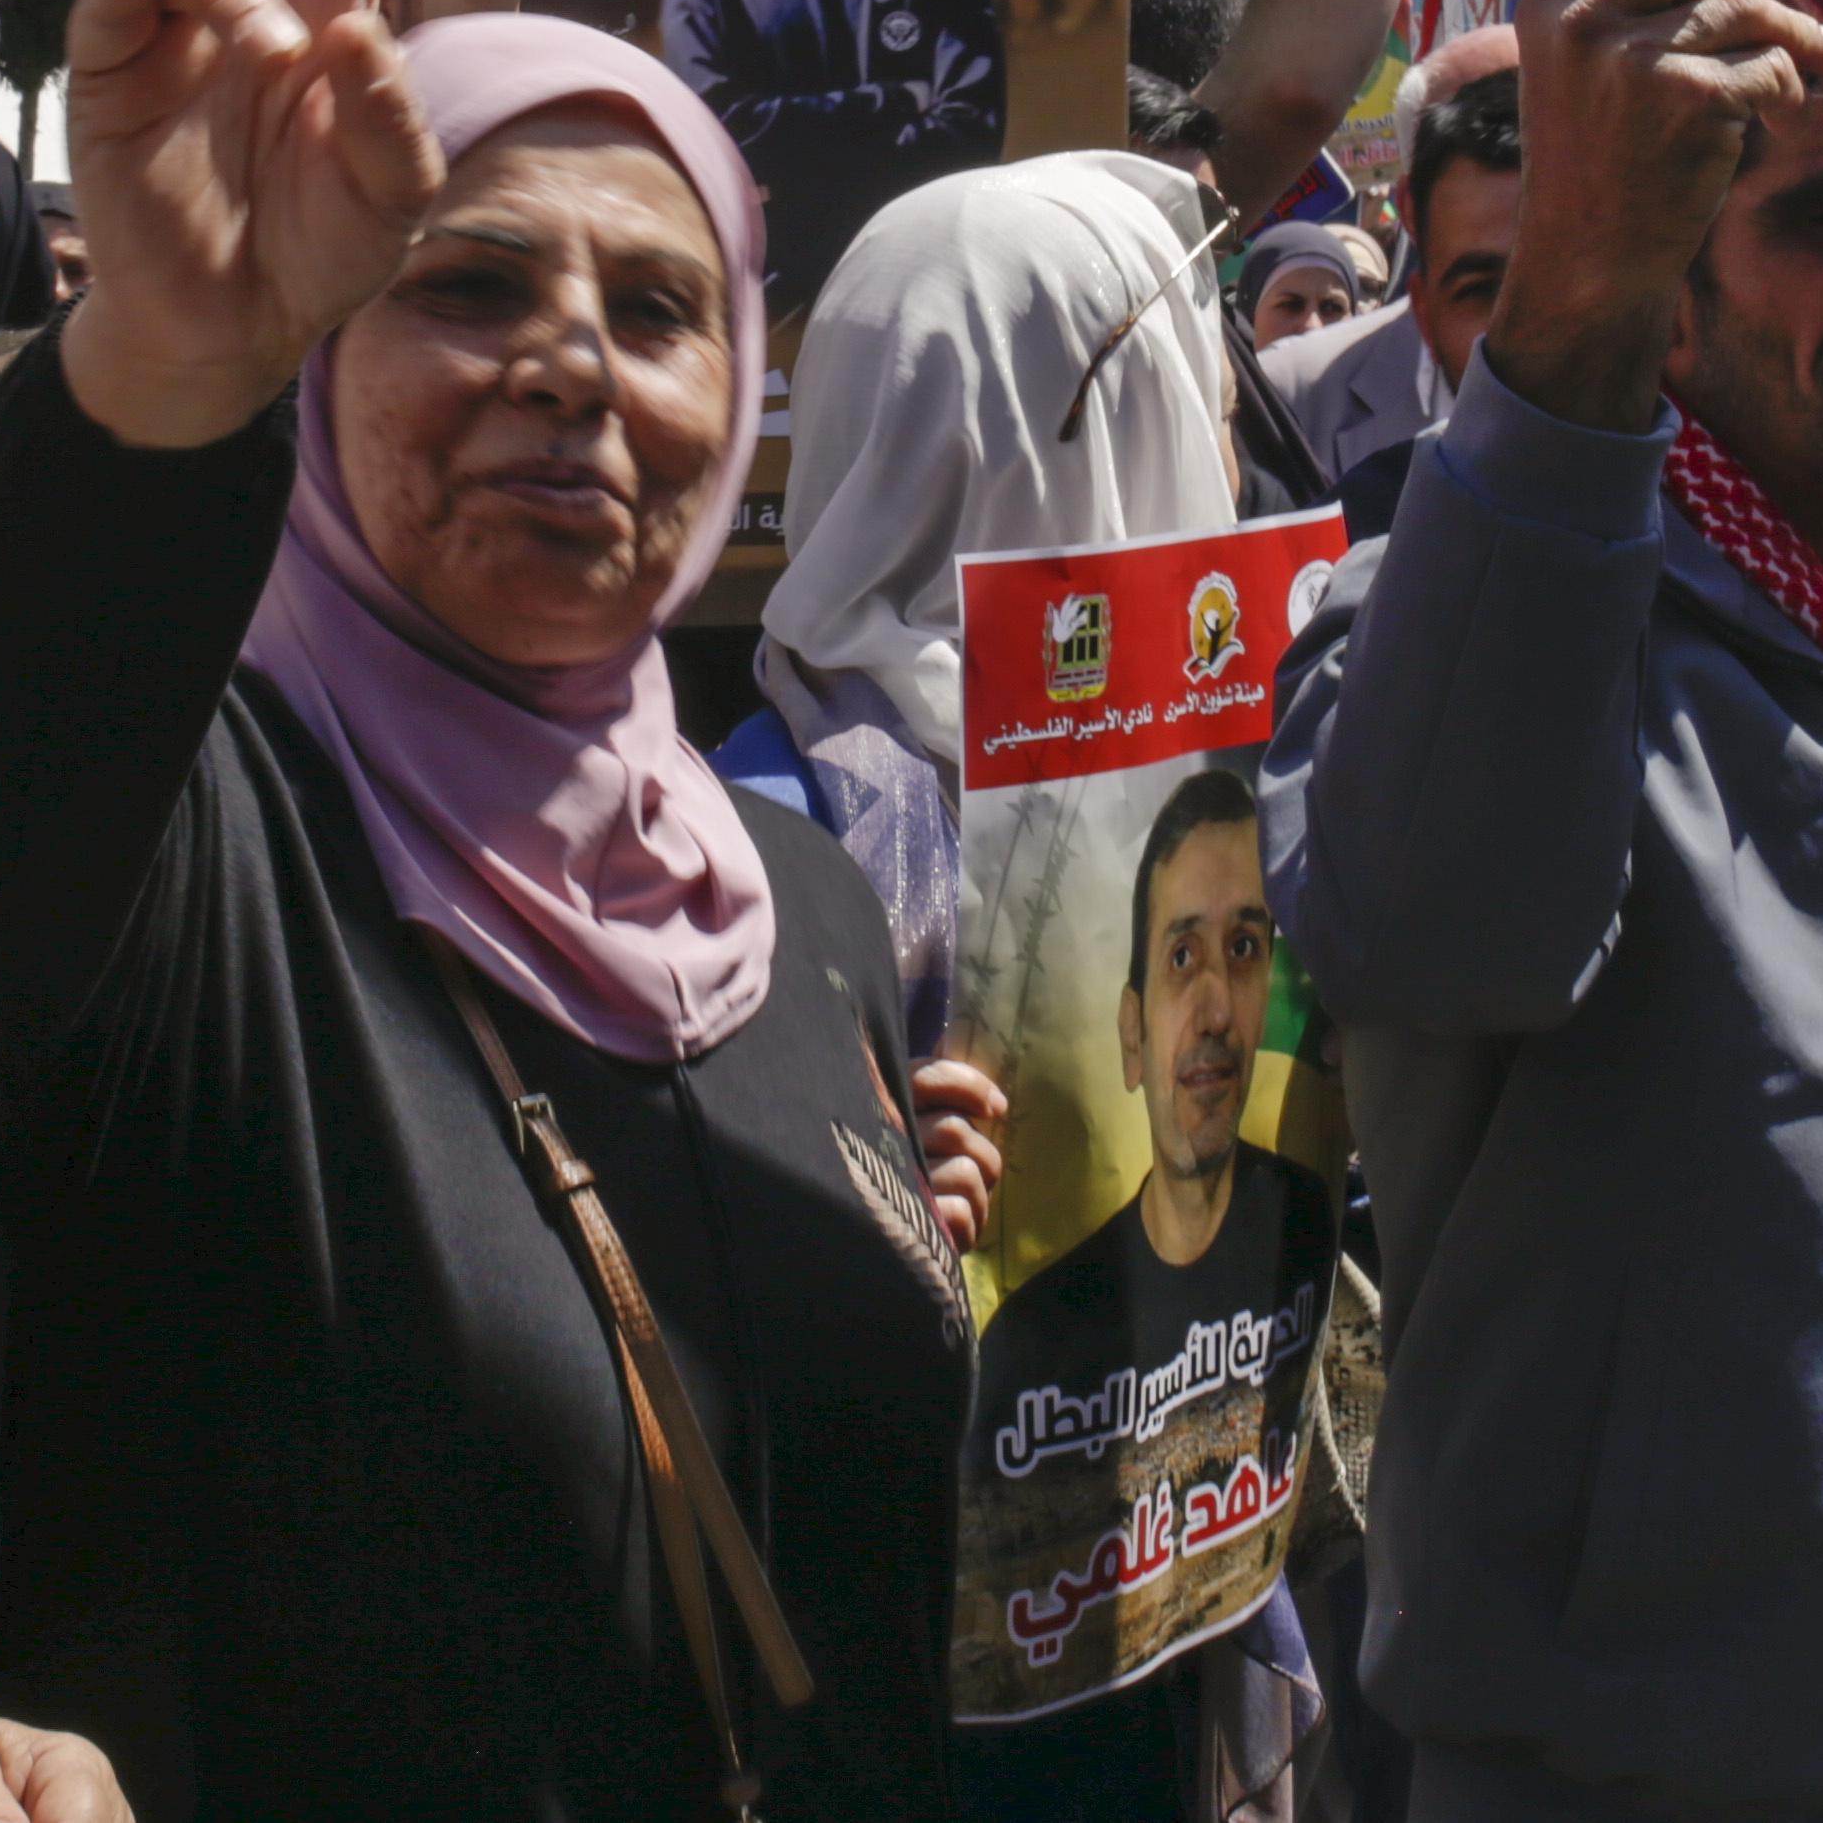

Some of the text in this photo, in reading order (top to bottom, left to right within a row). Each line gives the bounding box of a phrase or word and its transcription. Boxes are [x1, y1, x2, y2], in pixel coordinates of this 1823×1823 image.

[982, 702, 1154, 756] نادي الأسير الفلسطيني
[1163, 681, 1265, 723] هيئة شؤون الأسرى
[995, 1281, 1315, 1479] الحرية للأسير البطل
